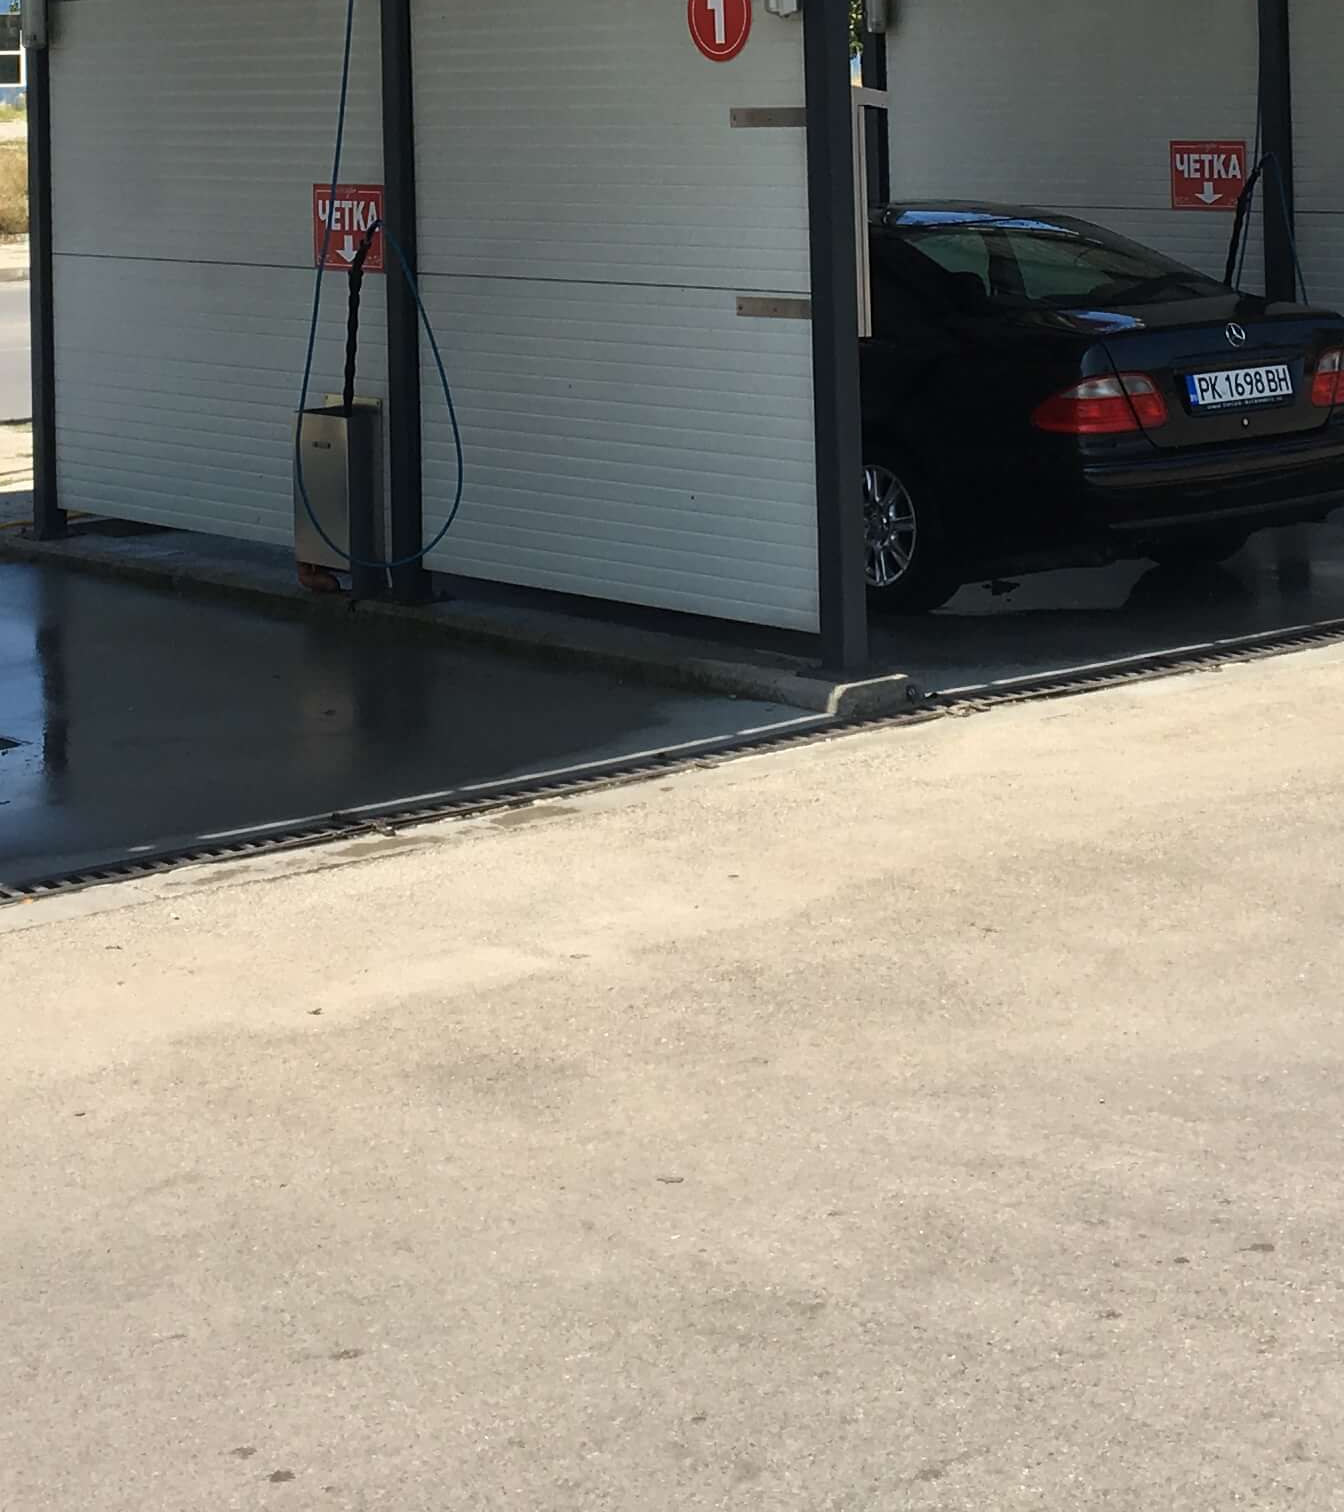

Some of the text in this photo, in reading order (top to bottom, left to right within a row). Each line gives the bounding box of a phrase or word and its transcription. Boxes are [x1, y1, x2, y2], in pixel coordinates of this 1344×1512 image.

[1175, 153, 1241, 179] ЧЕТКА
[318, 199, 379, 232] ЧЕТКА
[1197, 367, 1290, 401] PK 1698 BH
